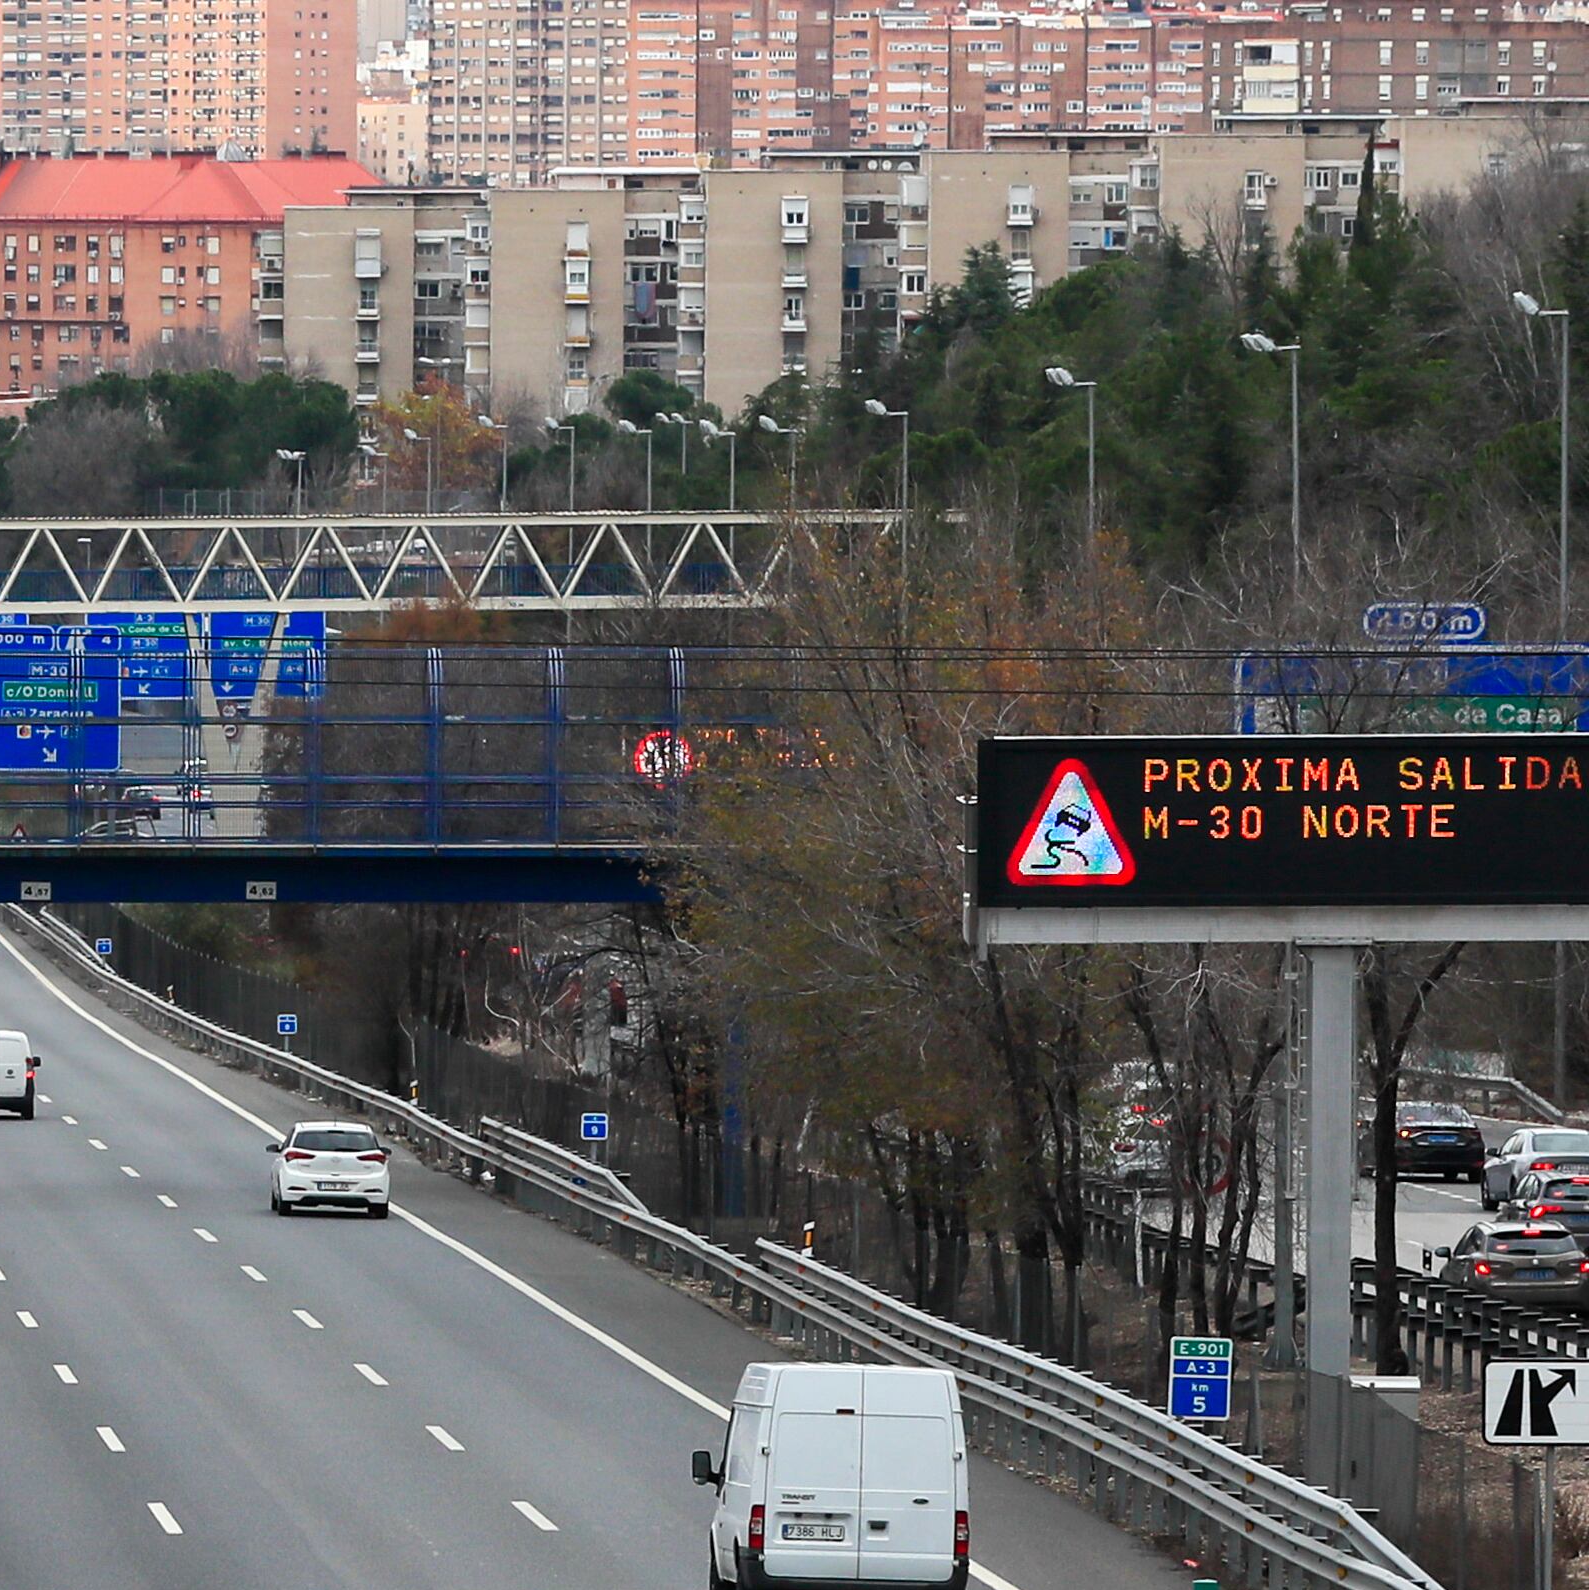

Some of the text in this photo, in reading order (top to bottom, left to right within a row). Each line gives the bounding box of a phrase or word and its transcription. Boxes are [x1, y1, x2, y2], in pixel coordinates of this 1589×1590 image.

[32, 635, 45, 645] m
[101, 635, 112, 645] 4
[31, 665, 68, 676] M-30
[1454, 705, 1488, 725] de
[1143, 756, 1584, 792] PROXIMA SALIDA
[1143, 803, 1456, 839] M-30 NORTE
[1179, 1343, 1224, 1356] E-901
[1186, 1361, 1216, 1374] A-3
[1191, 1382, 1210, 1392] km
[1191, 1396, 1207, 1413] 5
[788, 1525, 843, 1538] 7386 HLJ
